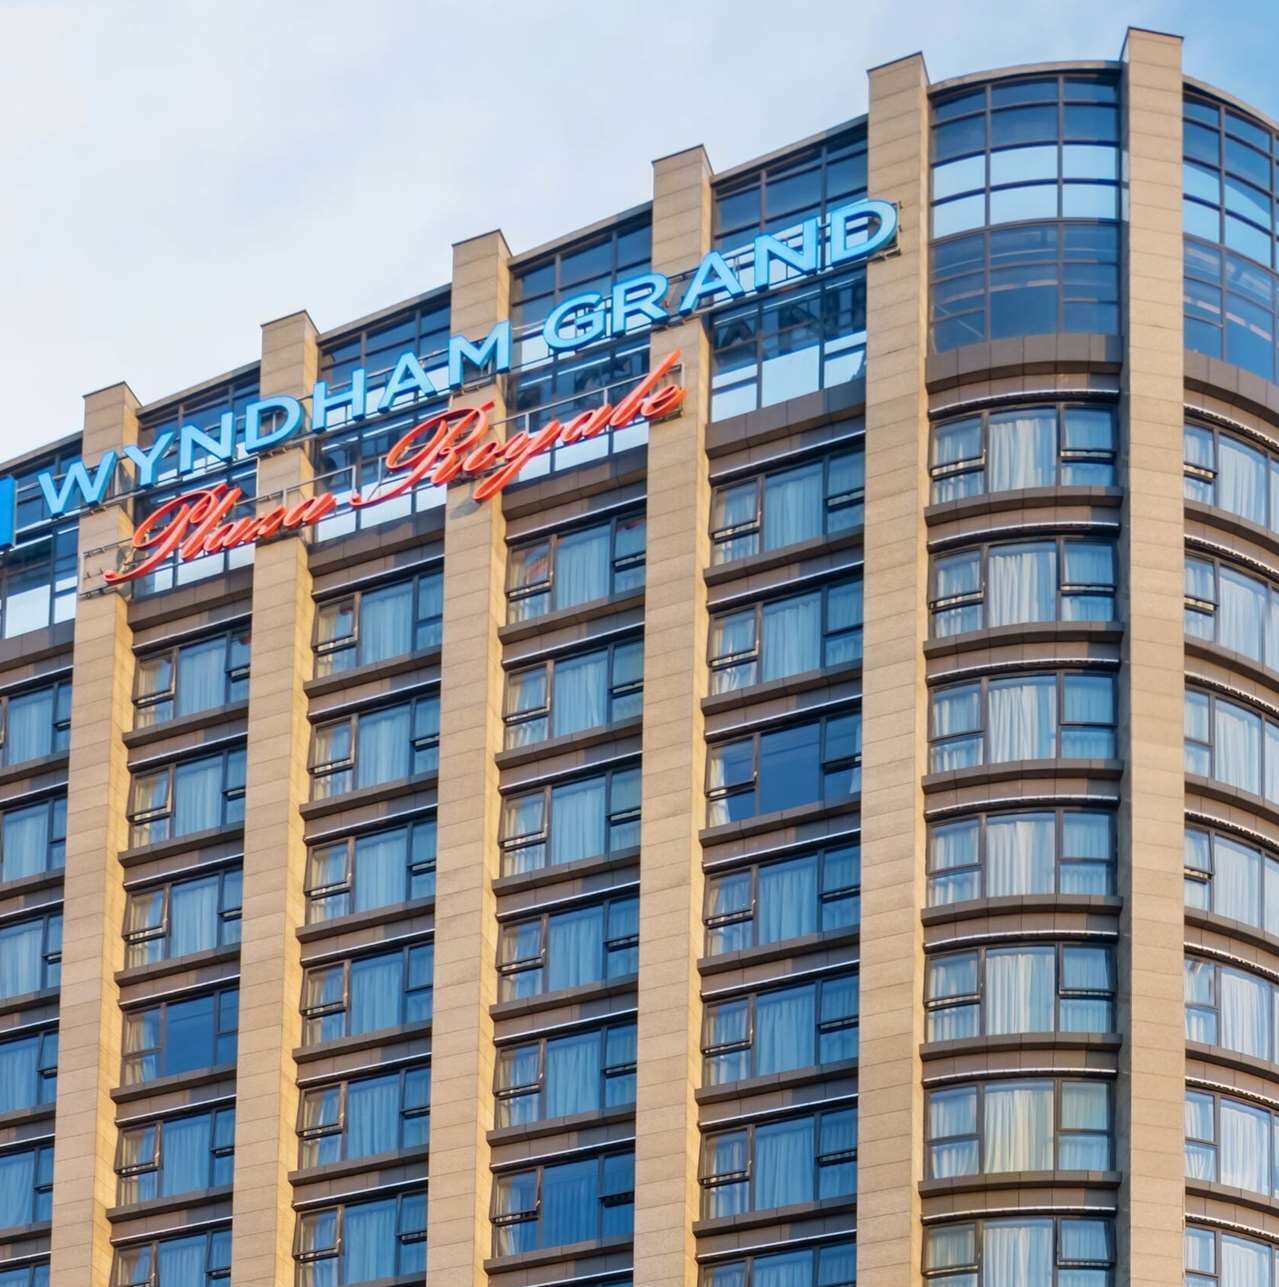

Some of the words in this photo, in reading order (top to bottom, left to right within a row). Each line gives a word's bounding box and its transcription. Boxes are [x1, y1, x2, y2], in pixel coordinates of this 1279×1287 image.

[37, 320, 513, 519] WYNDHAM
[543, 198, 899, 352] GRAND
[103, 483, 338, 584] Plaza
[349, 350, 687, 508] Royale
